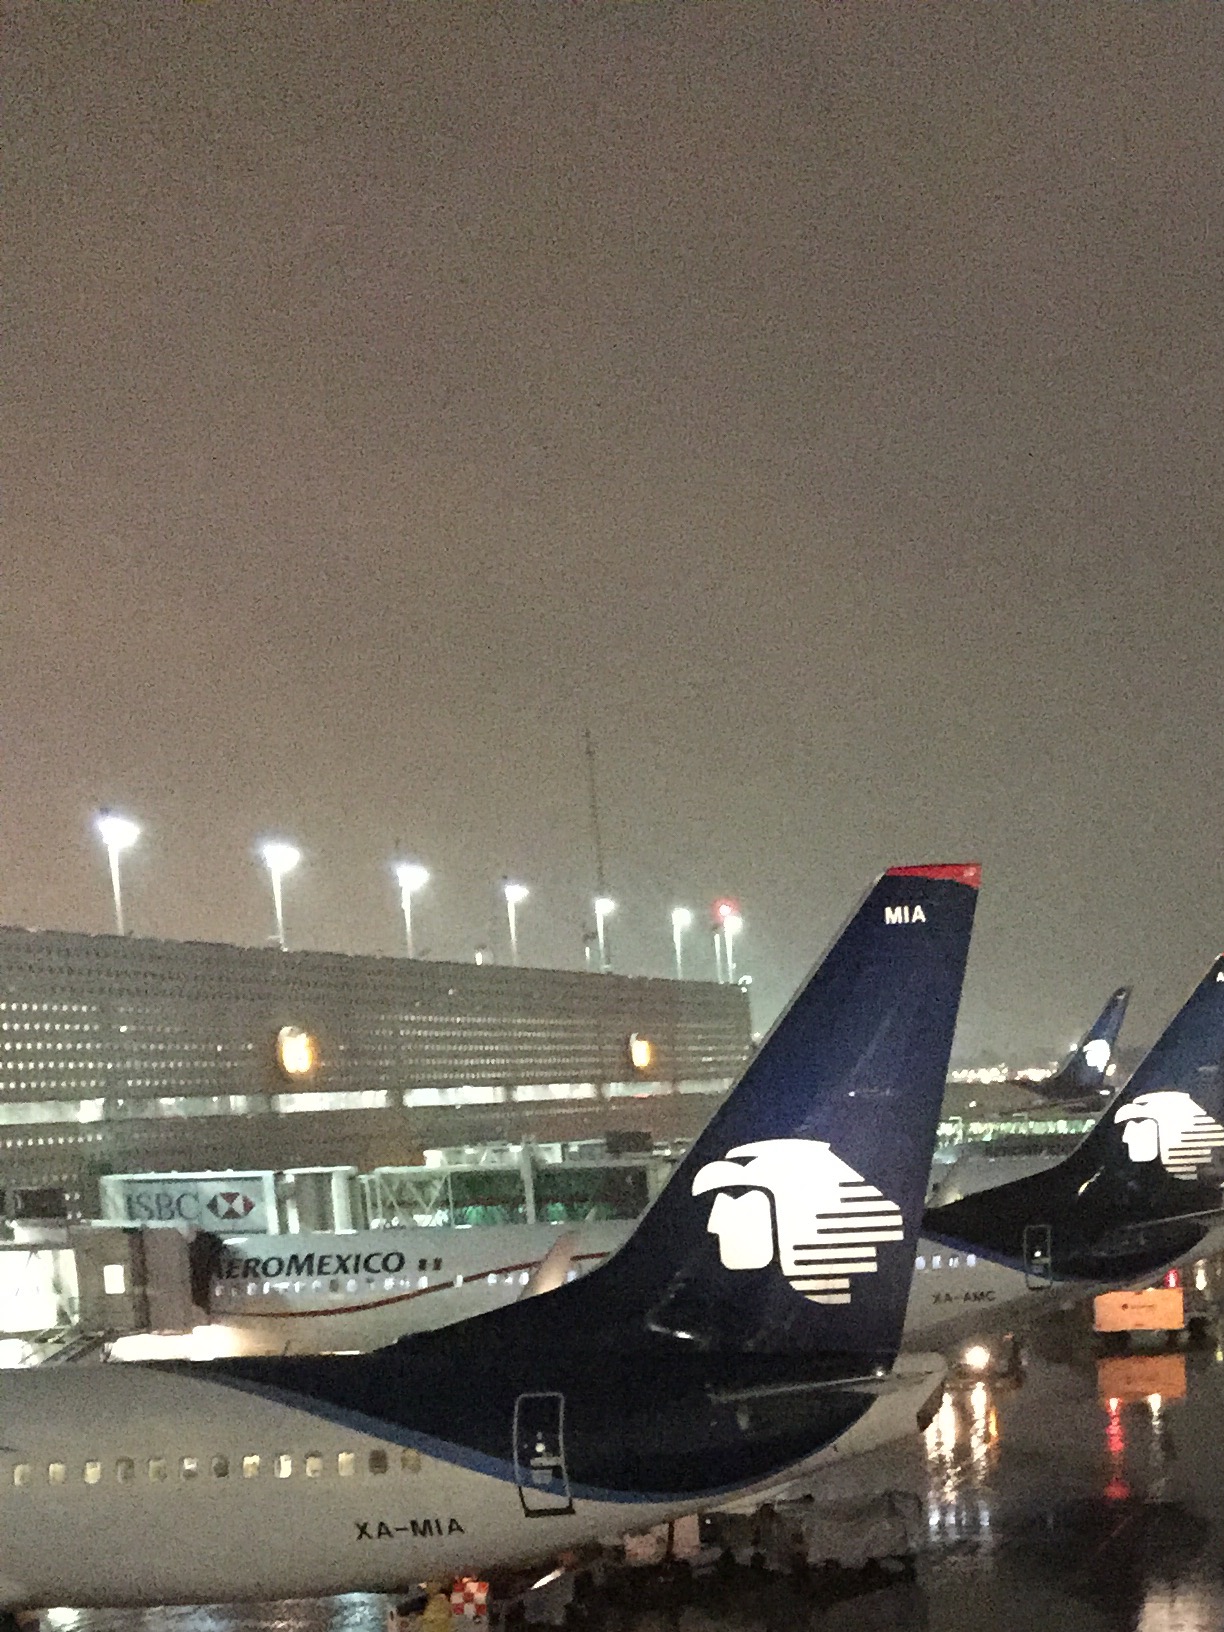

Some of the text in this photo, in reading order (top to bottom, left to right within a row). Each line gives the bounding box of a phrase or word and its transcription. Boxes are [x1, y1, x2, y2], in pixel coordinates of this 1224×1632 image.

[884, 905, 926, 925] MIA
[931, 1290, 996, 1304] XA-AMC
[355, 1518, 465, 1540] XA-MIA
